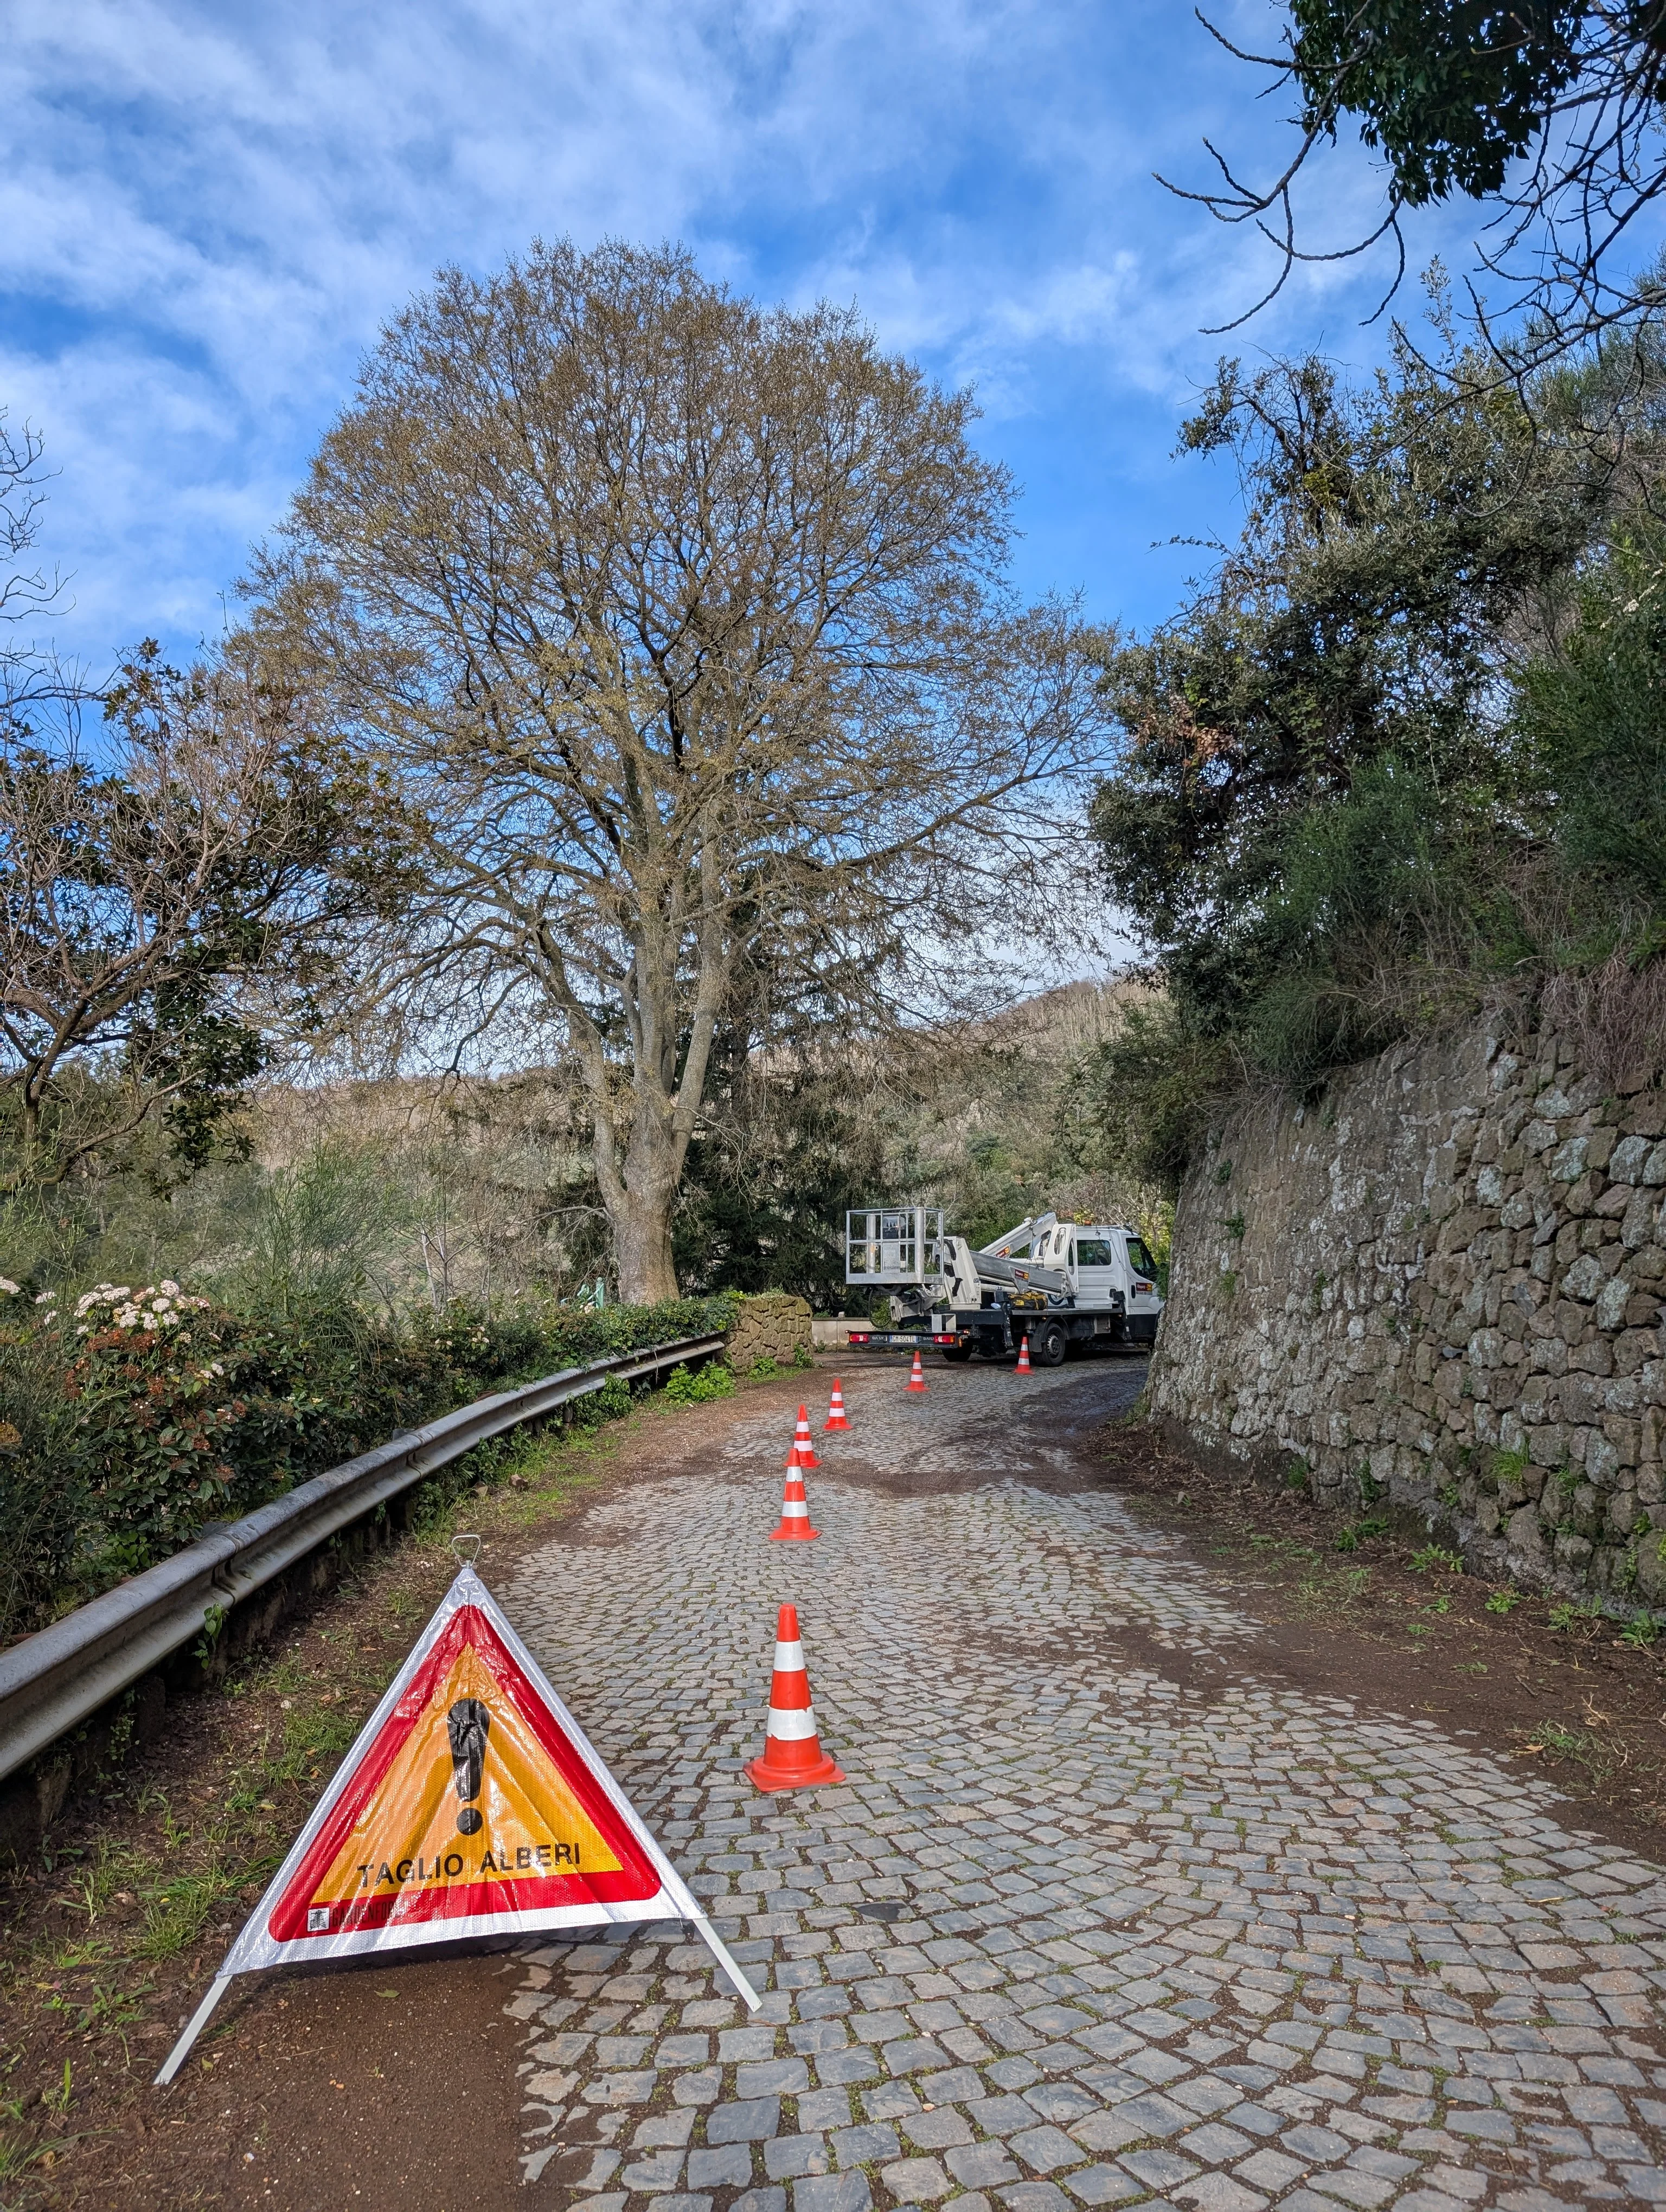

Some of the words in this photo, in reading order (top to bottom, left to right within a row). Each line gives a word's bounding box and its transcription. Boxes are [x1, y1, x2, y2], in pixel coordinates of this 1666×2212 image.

[357, 1853, 464, 1888] TAGLIO
[480, 1843, 580, 1874] ALBERI
[332, 1901, 400, 1927] GARDENFOR
